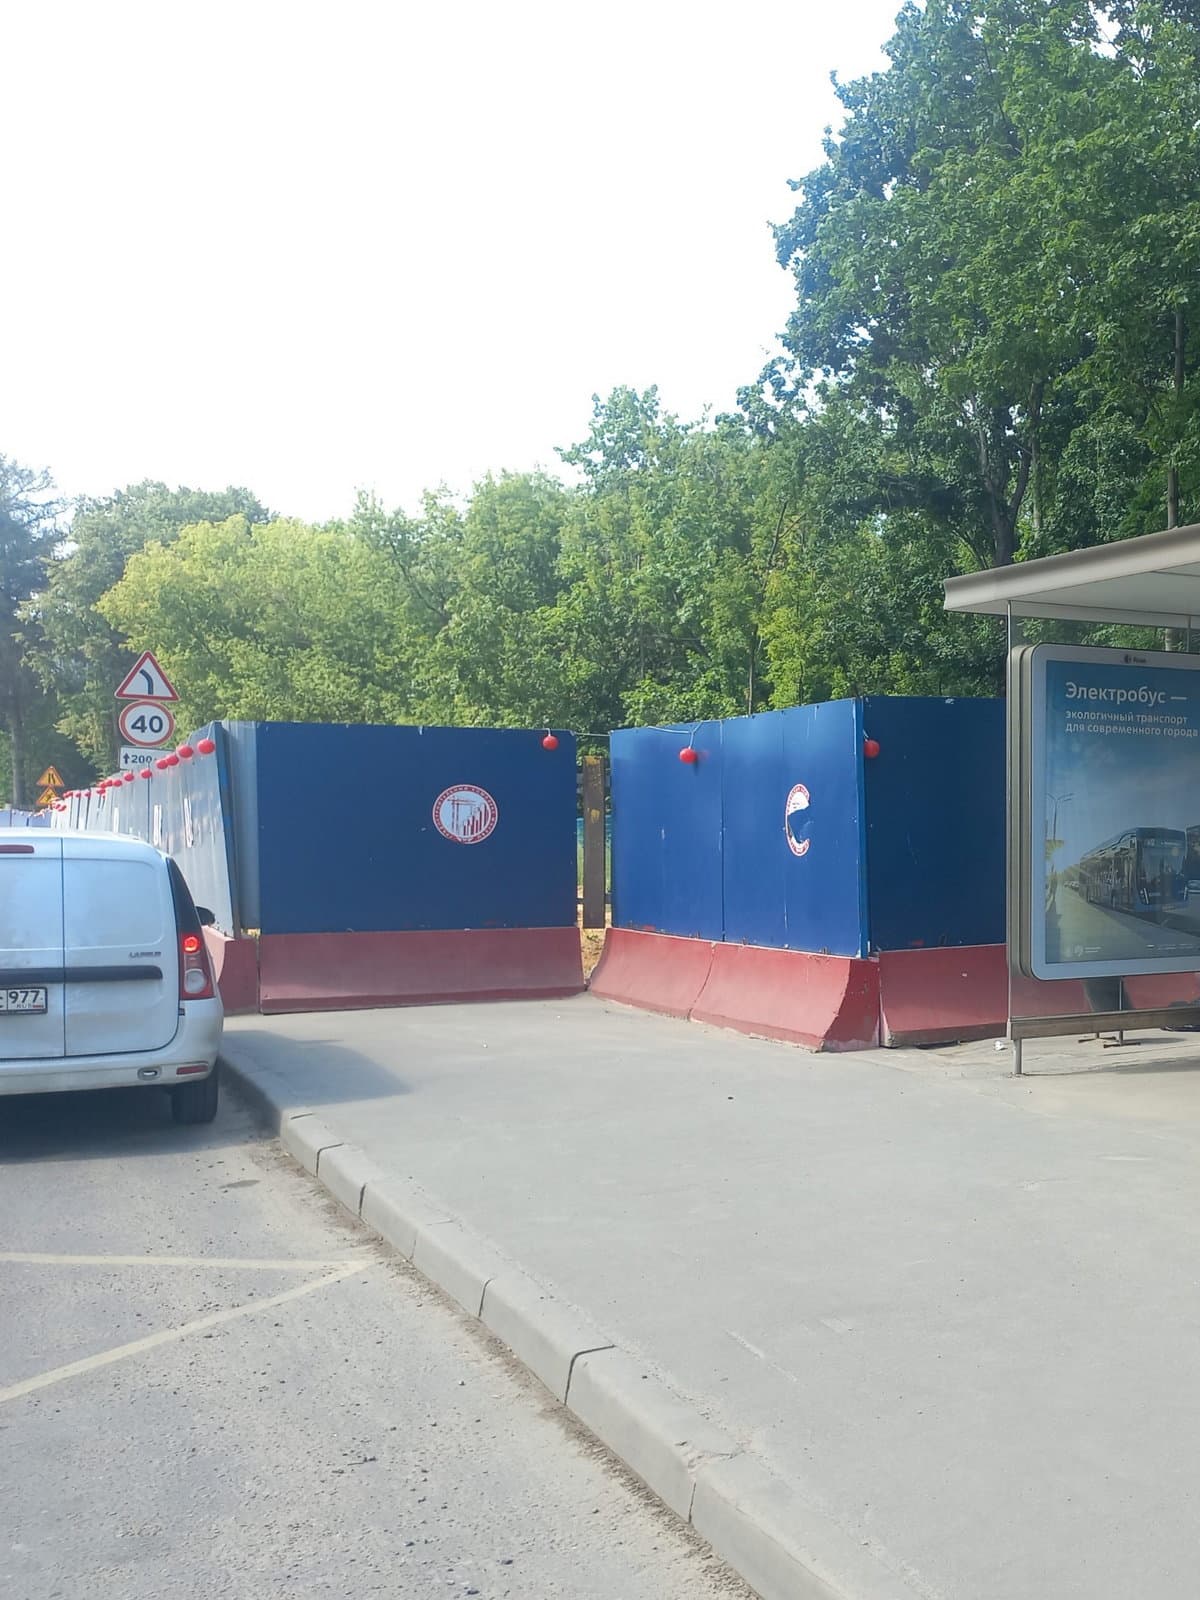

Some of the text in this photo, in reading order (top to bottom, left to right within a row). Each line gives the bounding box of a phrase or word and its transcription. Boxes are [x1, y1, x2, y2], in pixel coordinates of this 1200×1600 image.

[1065, 681, 1166, 707] Электробус
[131, 715, 164, 733] 40
[1065, 710, 1188, 725] экологичный транспорт
[1065, 722, 1199, 738] для современного города
[8, 990, 40, 1004] 977
